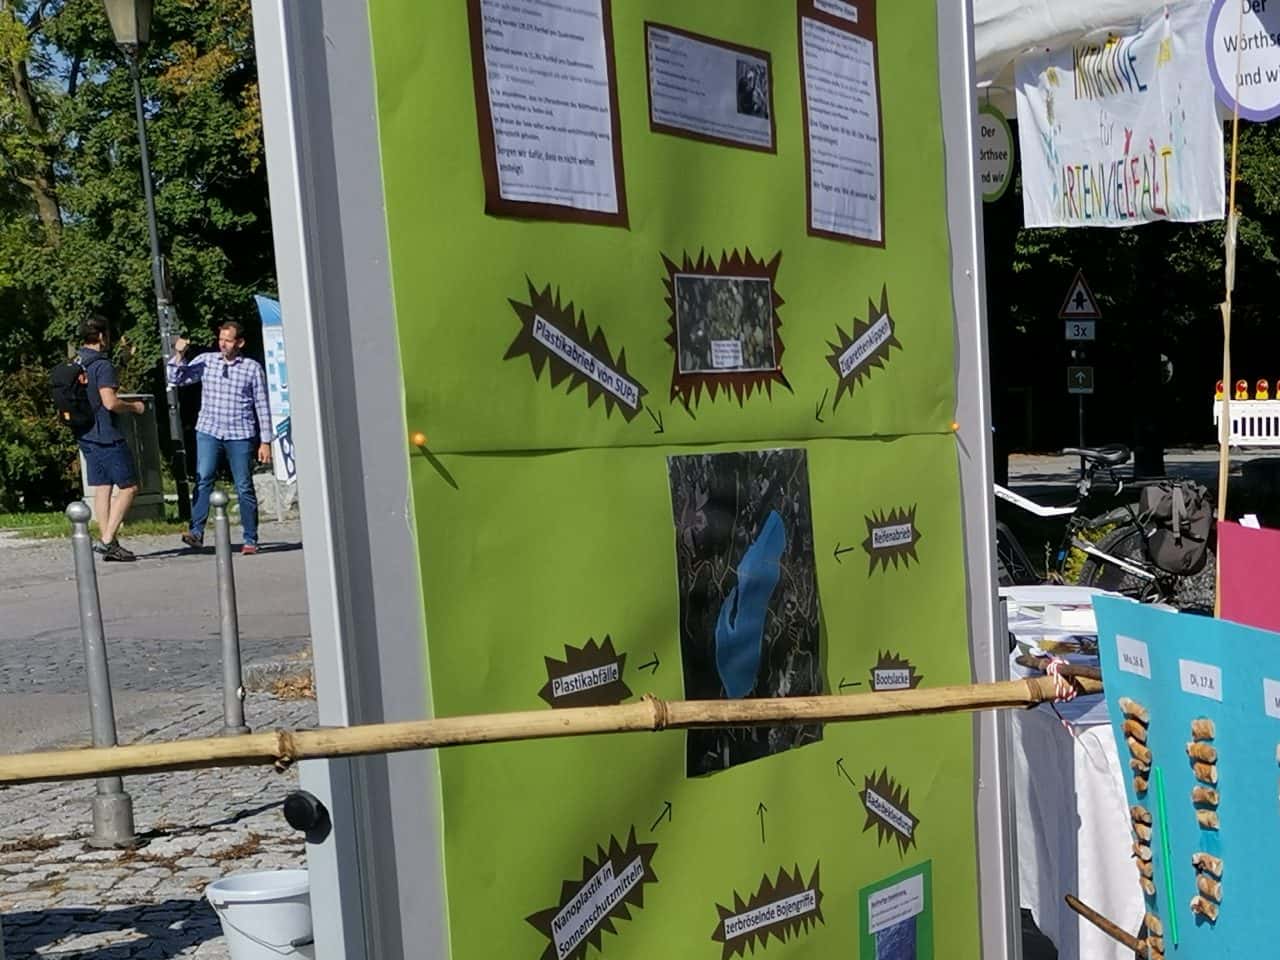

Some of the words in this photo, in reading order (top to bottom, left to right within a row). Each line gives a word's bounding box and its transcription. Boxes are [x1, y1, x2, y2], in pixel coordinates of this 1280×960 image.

[1242, 0, 1266, 14] Der
[981, 125, 996, 138] Der
[980, 148, 1008, 160] örthsee
[981, 170, 991, 183] nd
[1073, 325, 1088, 337] 3x
[535, 319, 595, 375] Plastikabrieb
[597, 369, 614, 388] von
[614, 379, 637, 403] SUPs
[554, 666, 618, 695] Plastikabfälle
[553, 877, 602, 934] Nanoplastik
[603, 867, 613, 883] in
[559, 863, 644, 958] Sonnenschutzmitteln
[726, 906, 775, 934] zerbröselnde
[776, 894, 814, 919] Bojengriffe
